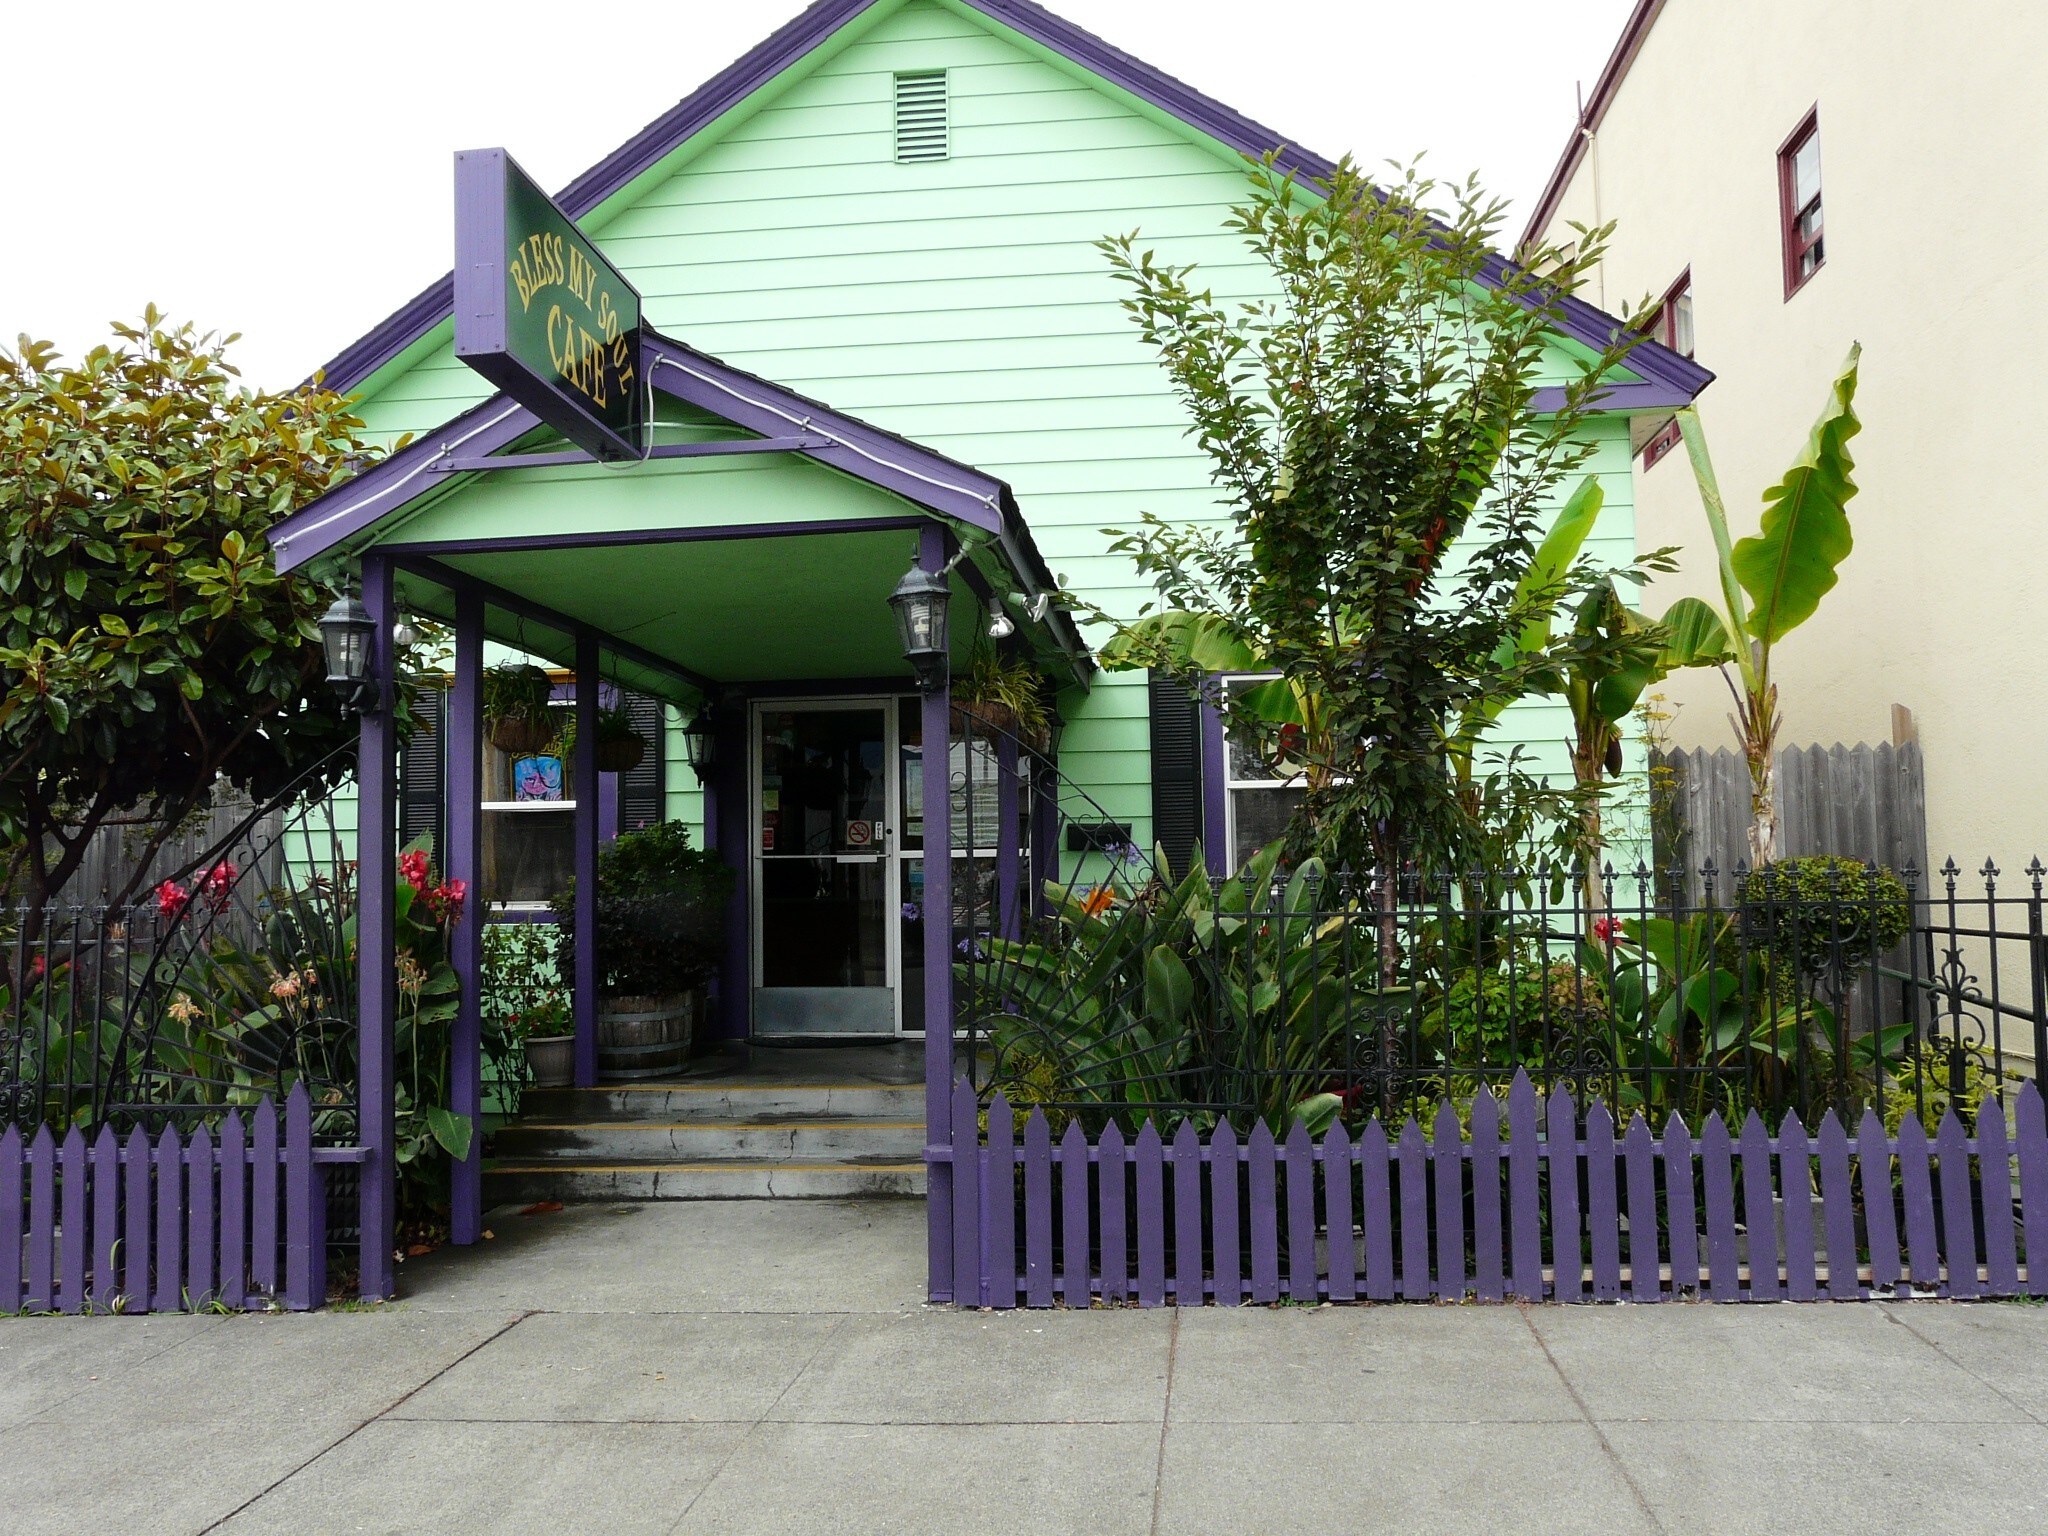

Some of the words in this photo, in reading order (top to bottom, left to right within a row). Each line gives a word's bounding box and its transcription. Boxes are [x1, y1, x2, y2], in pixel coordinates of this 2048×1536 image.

[510, 232, 564, 314] BLESS
[568, 243, 597, 312] MY
[597, 292, 634, 395] SOUL
[547, 304, 606, 410] CAFE
